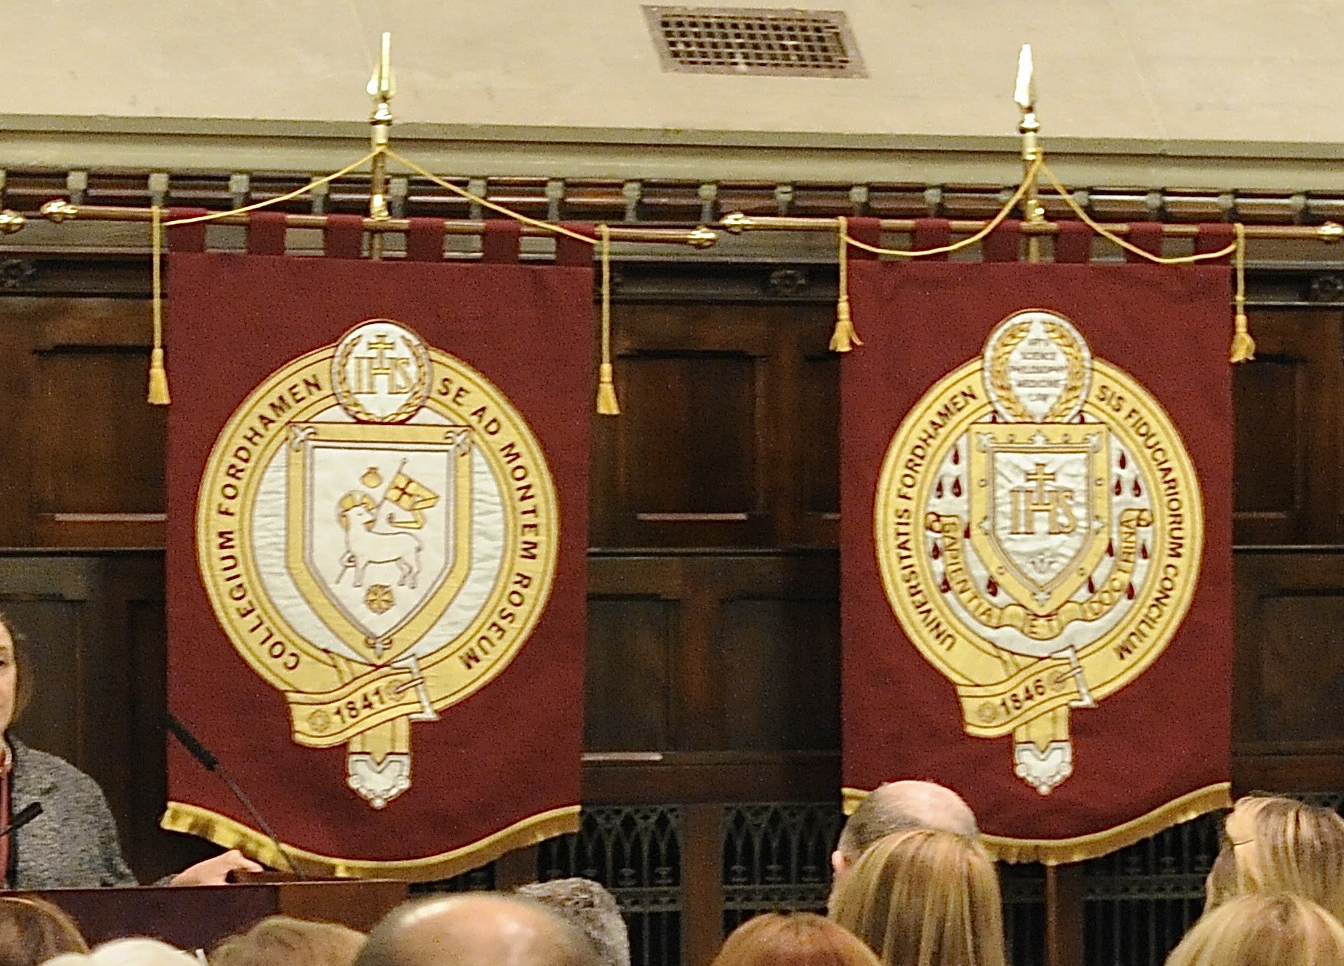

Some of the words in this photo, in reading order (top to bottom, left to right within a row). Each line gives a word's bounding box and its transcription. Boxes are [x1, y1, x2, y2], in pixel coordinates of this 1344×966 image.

[438, 378, 468, 404] SE
[470, 404, 501, 438] AD
[1097, 385, 1125, 413] SIS
[218, 375, 323, 516] FORDHAMEN
[899, 385, 979, 501] FORDHAMEN
[1123, 409, 1183, 558] FIDUCIARIORUM
[500, 441, 540, 562] MONTEM
[1010, 489, 1077, 535] IHS
[218, 529, 299, 671] COLLEGIUM
[459, 571, 533, 671] ROSEUM
[893, 509, 955, 652] UNIVERSITATIS
[1117, 564, 1179, 661] CONCILIUM
[334, 690, 386, 724] 1841
[999, 679, 1046, 715] 1846
